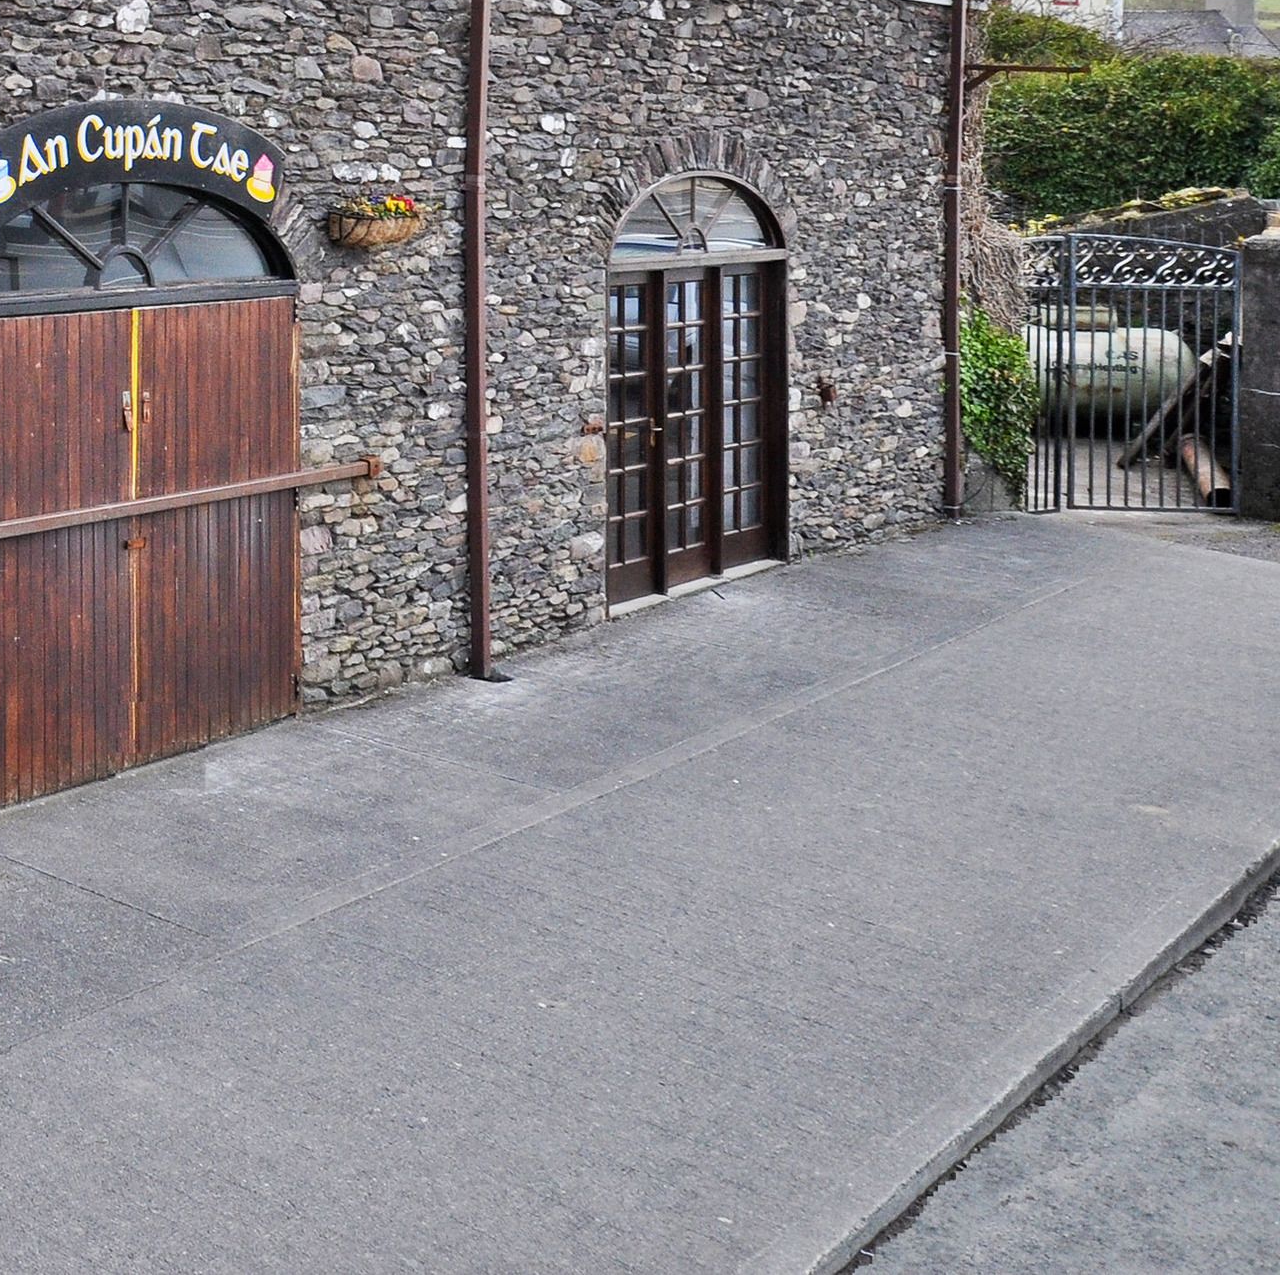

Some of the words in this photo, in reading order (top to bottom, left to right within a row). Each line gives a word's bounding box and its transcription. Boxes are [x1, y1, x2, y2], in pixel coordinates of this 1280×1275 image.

[18, 133, 69, 187] An
[76, 114, 183, 172] Cupán
[190, 121, 250, 181] Tae
